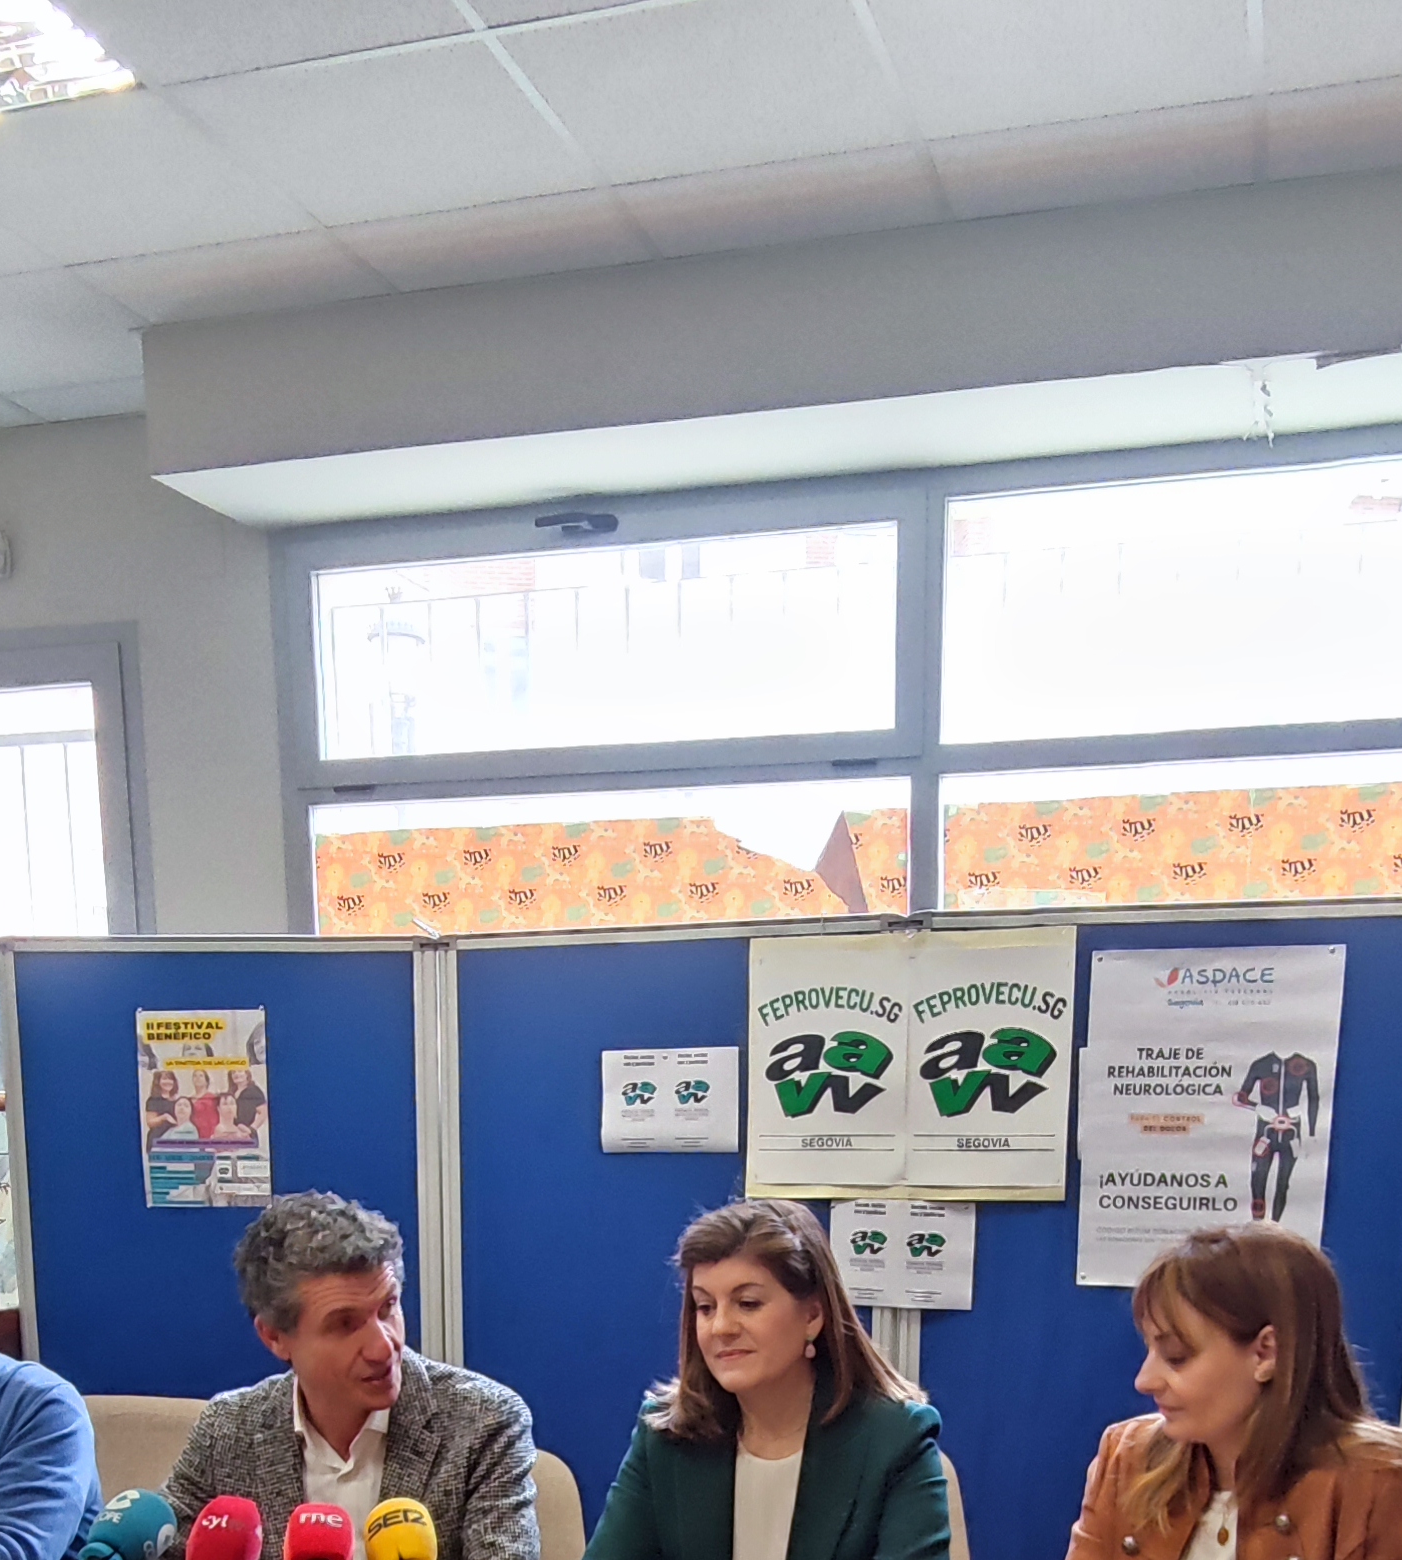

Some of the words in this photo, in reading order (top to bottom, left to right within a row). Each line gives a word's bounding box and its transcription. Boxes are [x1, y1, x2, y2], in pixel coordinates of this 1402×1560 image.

[1180, 966, 1275, 987] ASPACE
[757, 986, 903, 1026] FEPROVECU.SG
[912, 981, 1068, 1023] FEPROVECU.SG
[146, 1022, 154, 1031] II
[156, 1021, 224, 1031] FESTIVAL
[147, 1030, 212, 1041] BENÉFICO
[1136, 1047, 1181, 1061] TRAJE
[1185, 1047, 1205, 1060] DE
[1106, 1061, 1233, 1079] REHABILITACIÓN
[1112, 1079, 1224, 1097] NEUROLÓGICA
[800, 1136, 853, 1148] SEGOVIA
[956, 1137, 1010, 1149] SEGOVIA
[1099, 1168, 1211, 1189] ¡AYÚDANOS
[1215, 1173, 1228, 1189] A
[1097, 1194, 1238, 1212] CONSEGUIRLO
[98, 1511, 123, 1524] OPE
[299, 1512, 344, 1528] rne
[368, 1508, 427, 1541] SER
